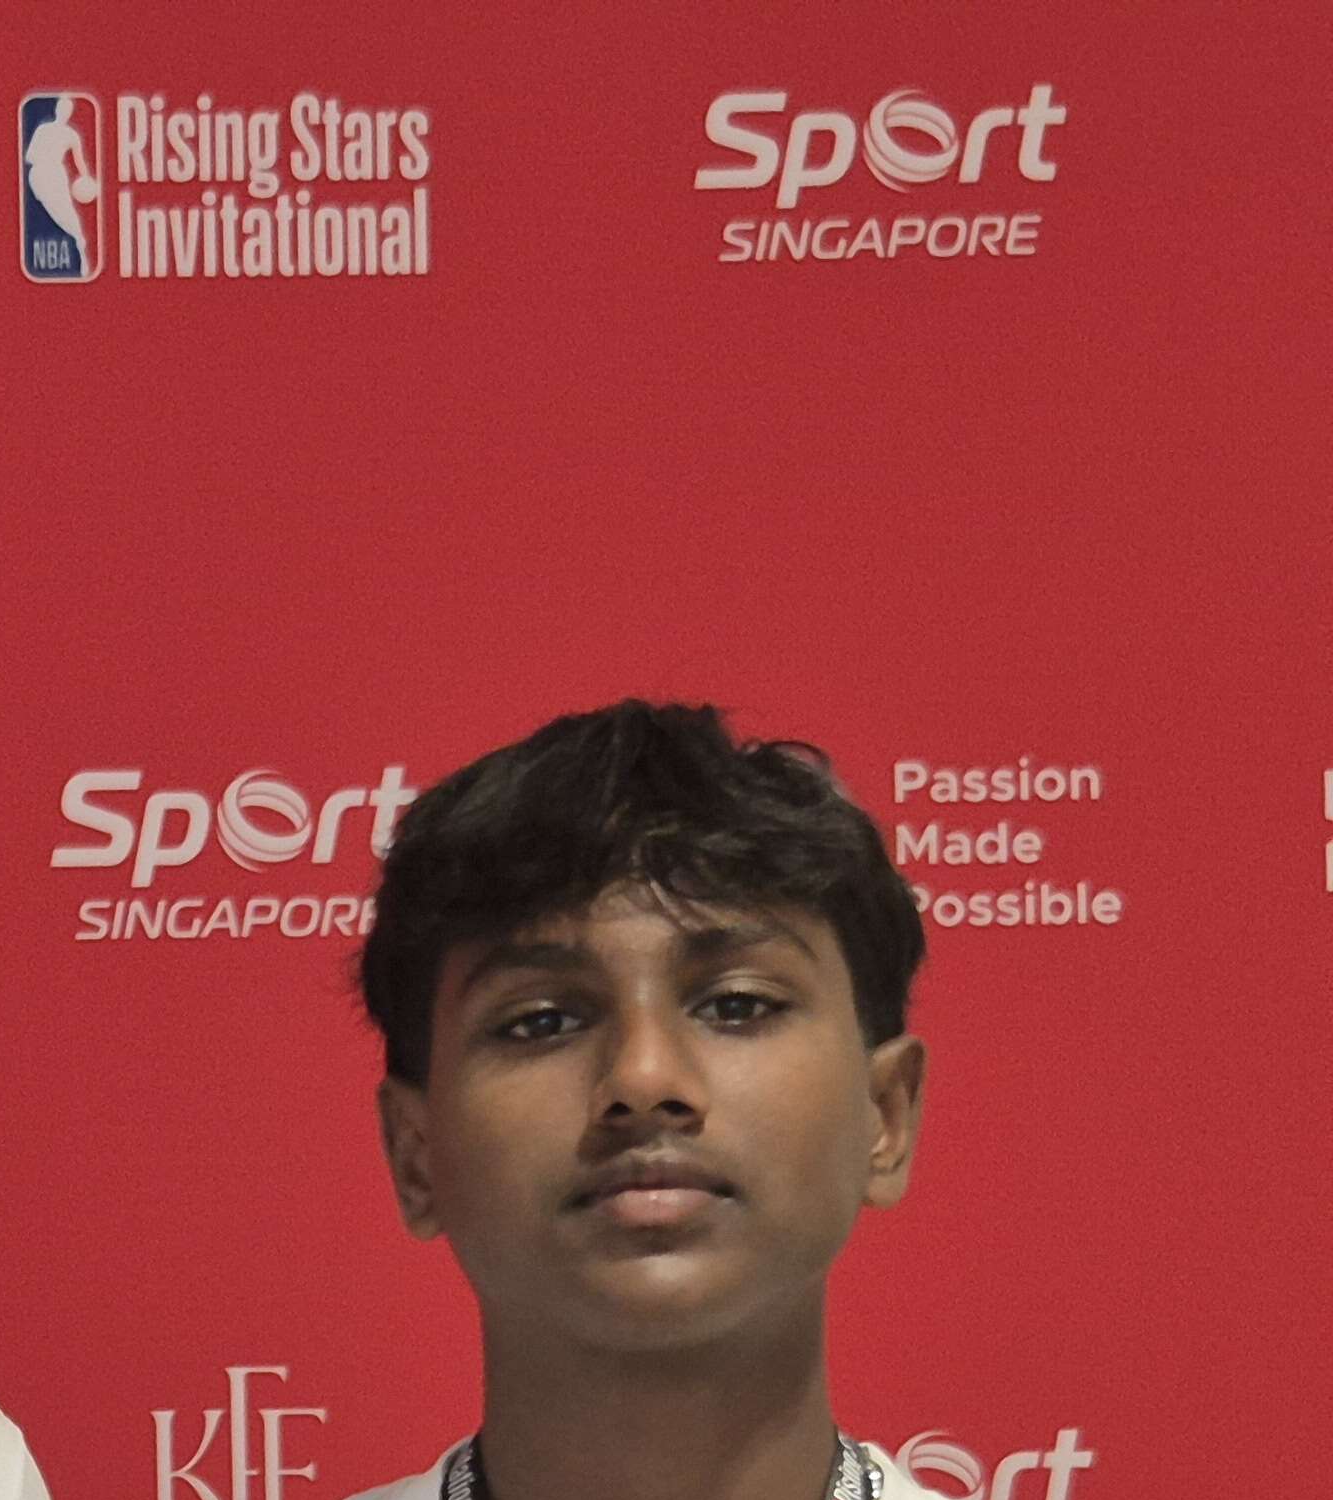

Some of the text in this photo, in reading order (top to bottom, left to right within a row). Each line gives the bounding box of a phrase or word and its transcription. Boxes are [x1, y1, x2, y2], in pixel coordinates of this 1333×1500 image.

[117, 92, 431, 198] Rising Stars
[694, 85, 1066, 208] Sport
[33, 241, 71, 270] NBA
[117, 187, 430, 280] Invitational
[718, 214, 1041, 262] SINGAPORE
[894, 757, 1101, 802] Passion
[895, 823, 1043, 865] Made
